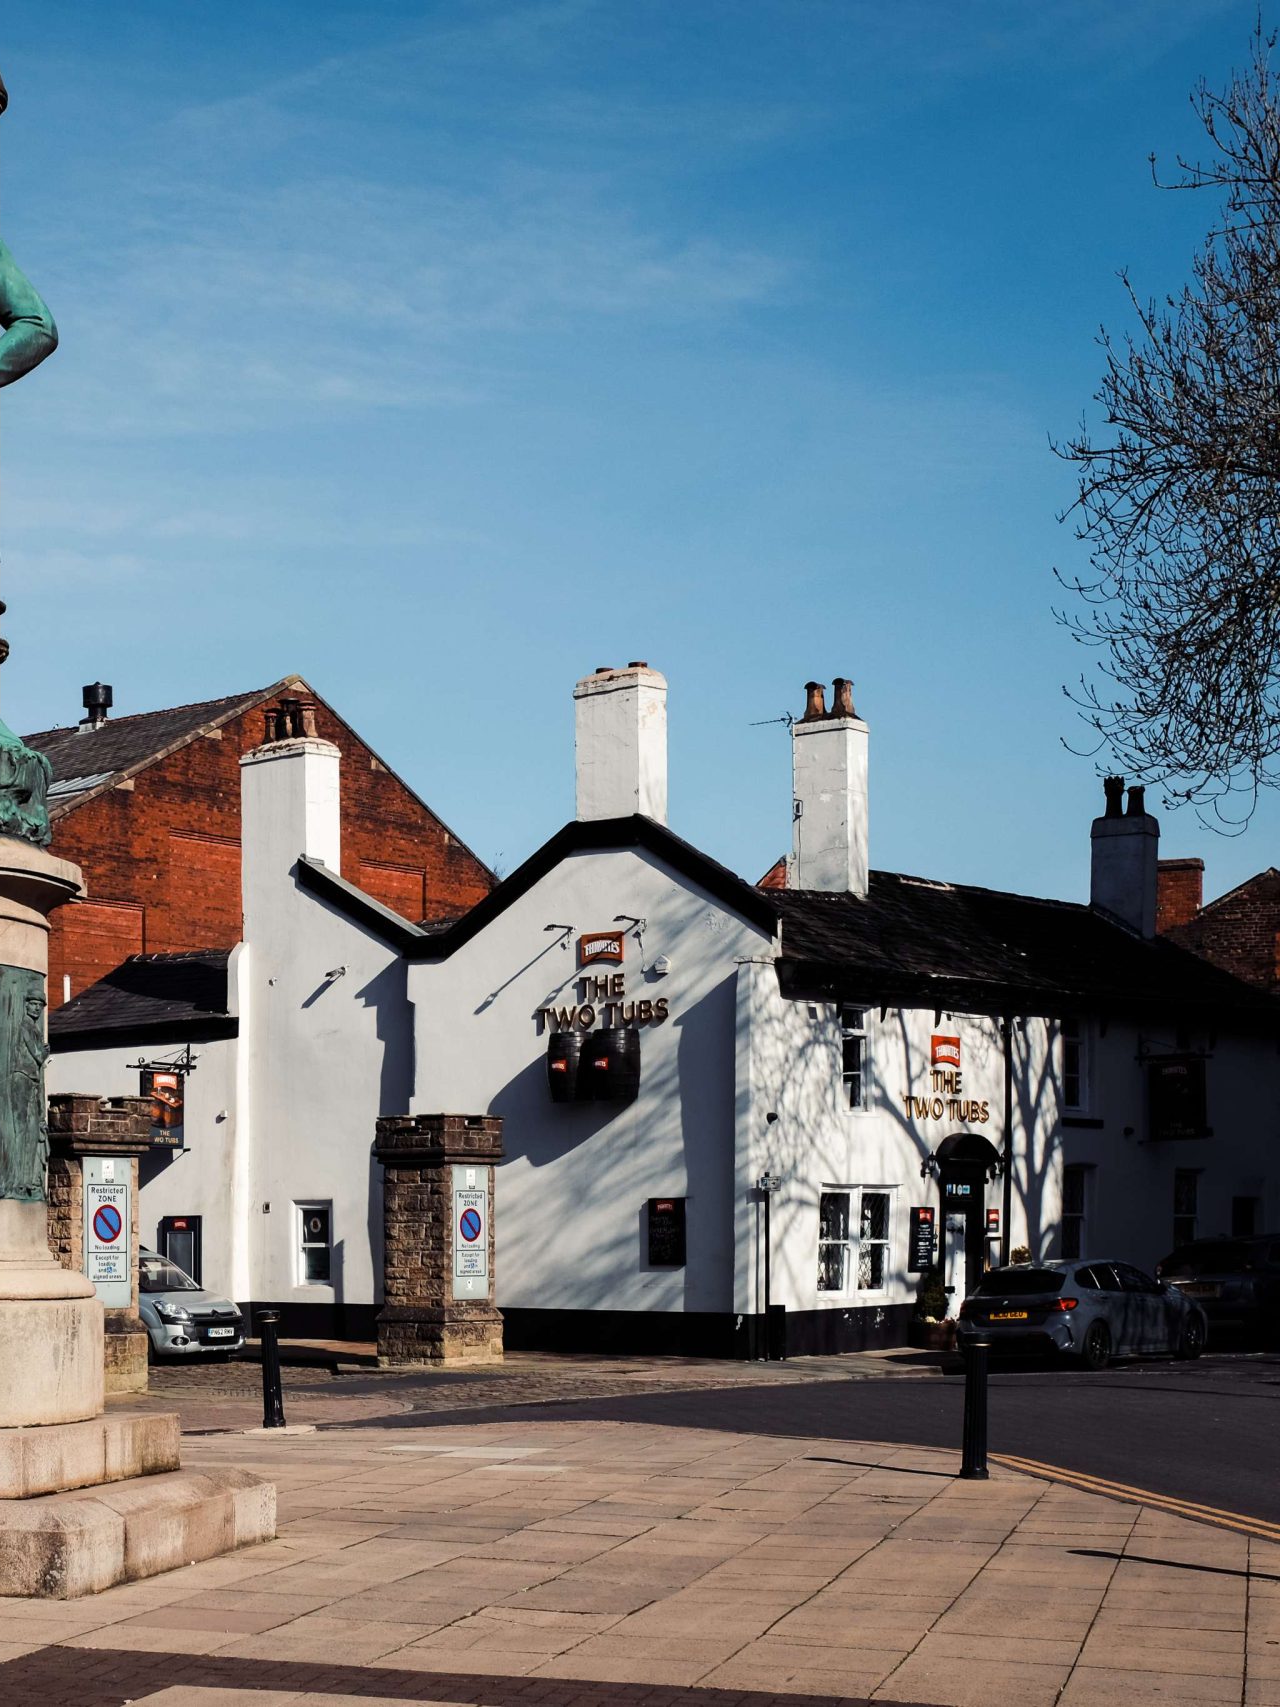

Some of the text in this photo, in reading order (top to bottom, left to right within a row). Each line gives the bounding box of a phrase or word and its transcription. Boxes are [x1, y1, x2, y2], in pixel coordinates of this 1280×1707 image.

[579, 973, 625, 1002] THE
[536, 997, 669, 1033] TWO TUBS
[930, 1069, 962, 1094] THE
[903, 1095, 990, 1123] TWO TUBS
